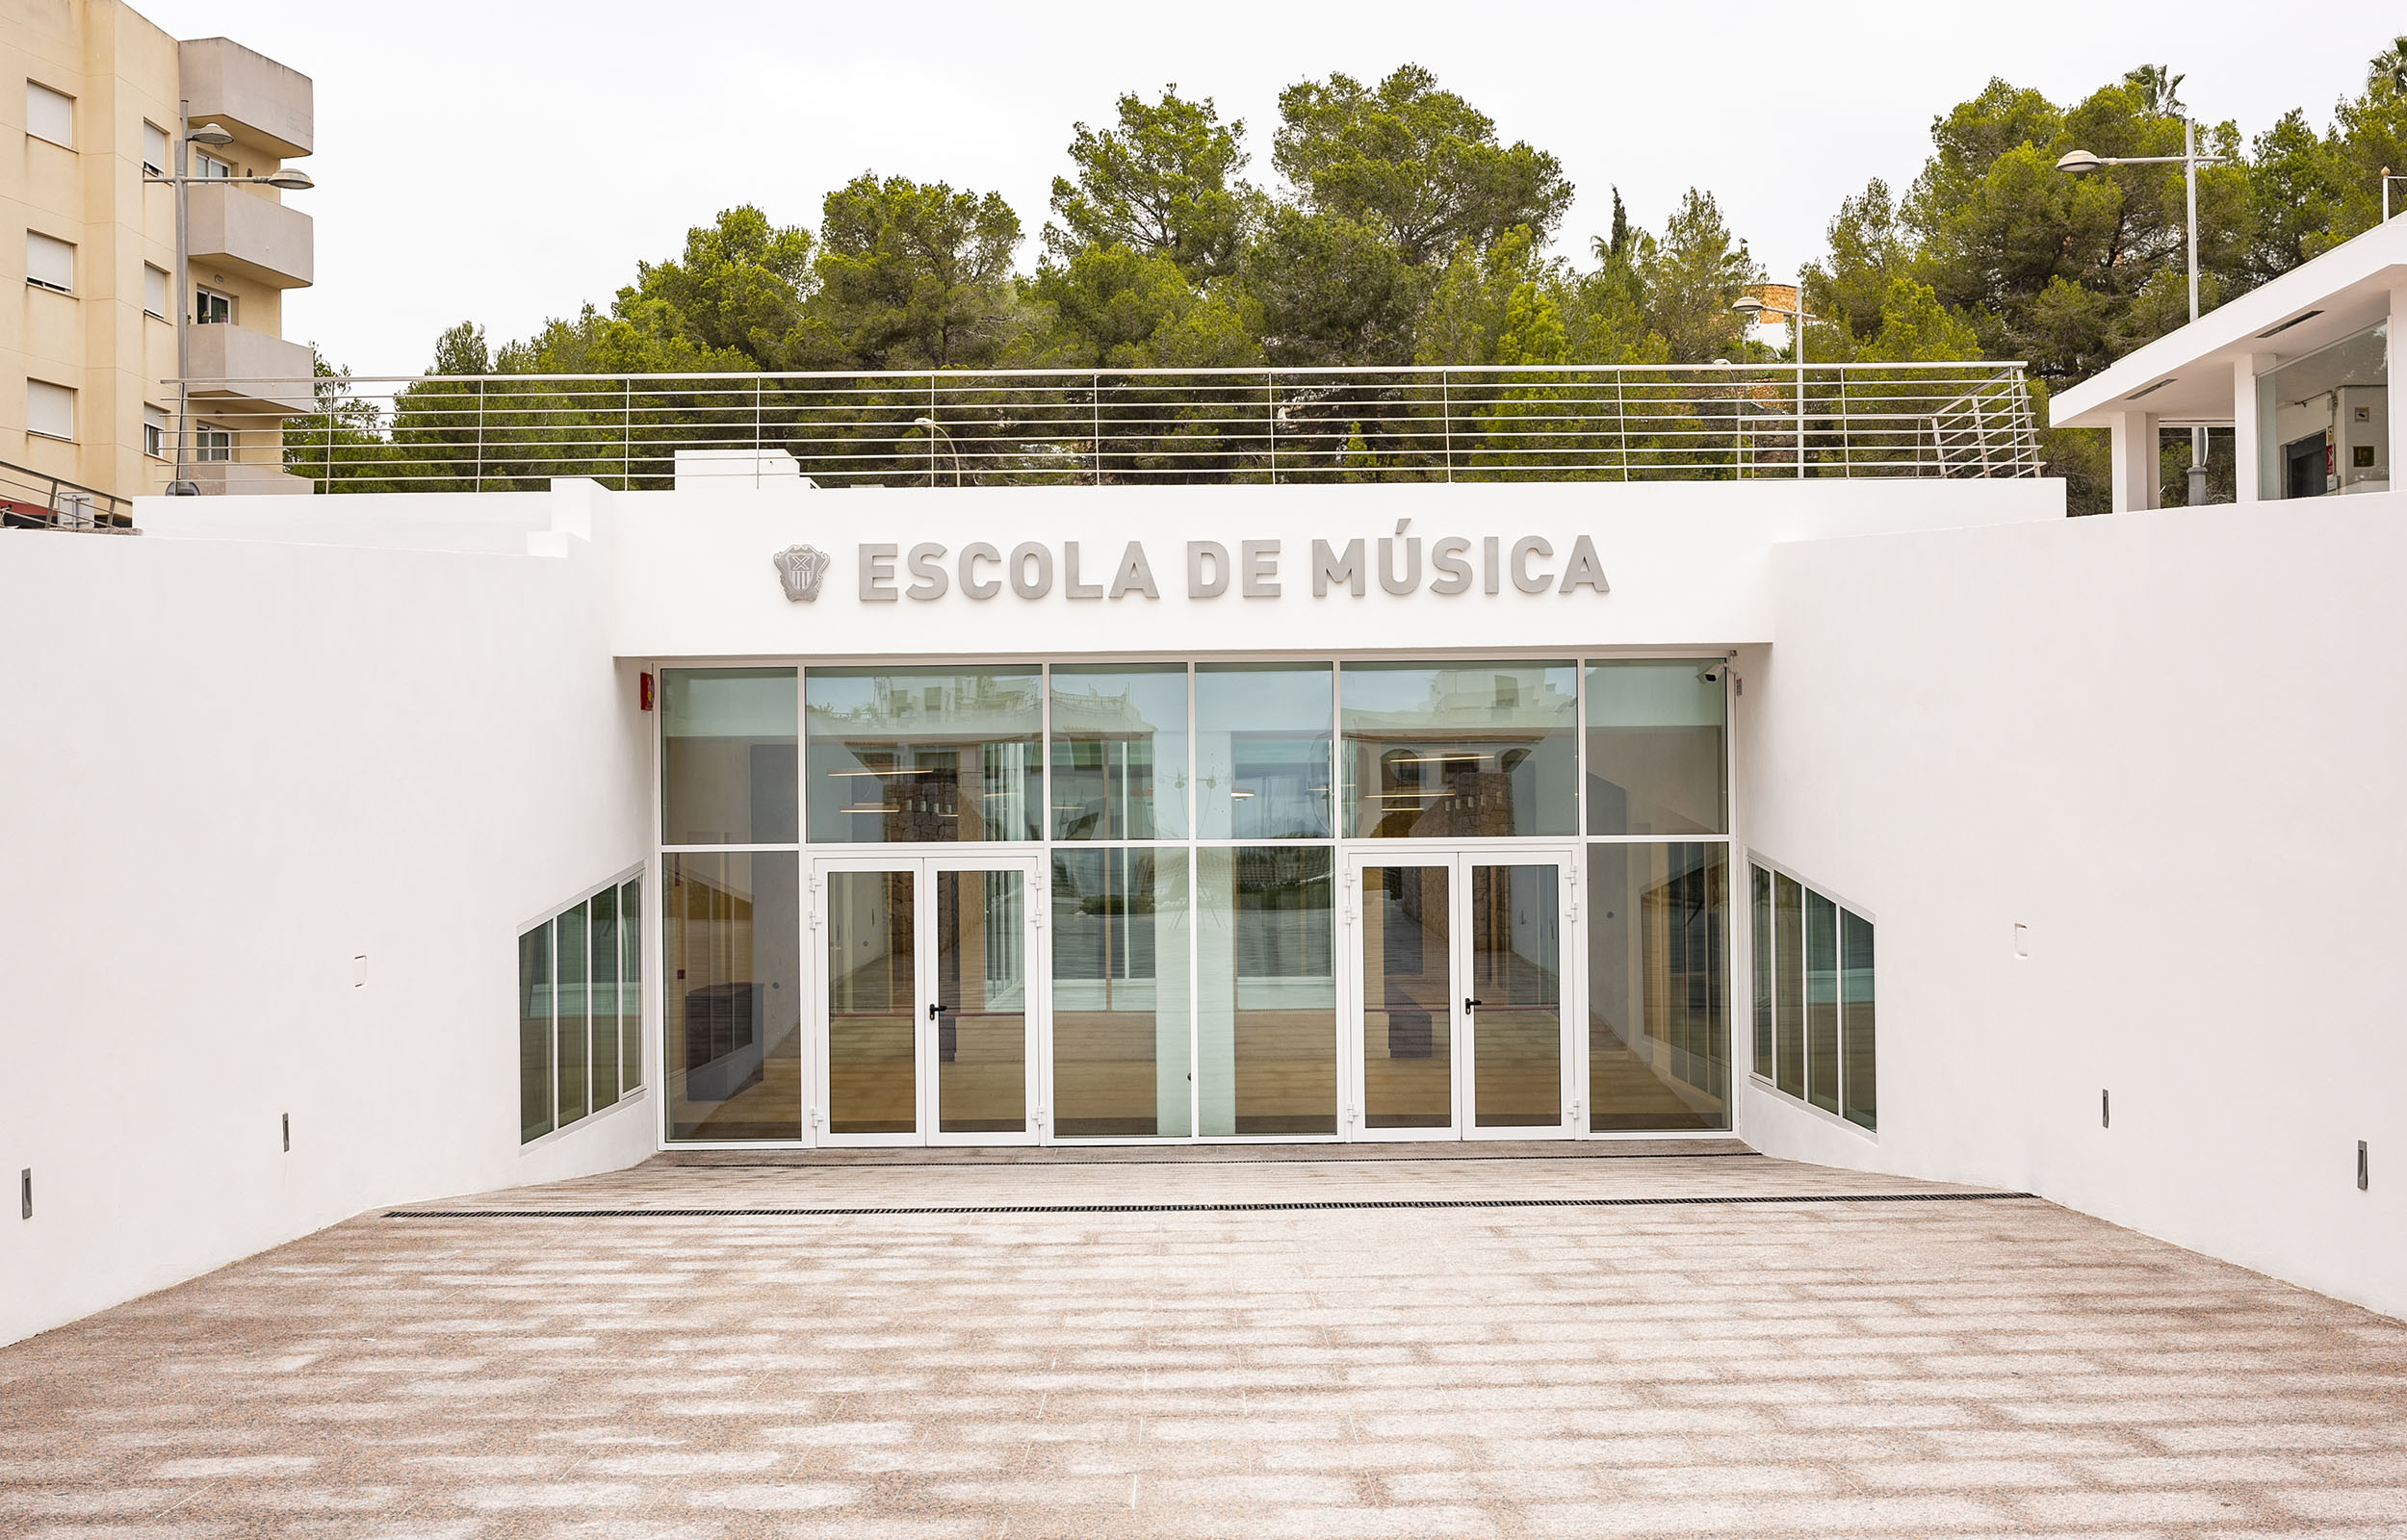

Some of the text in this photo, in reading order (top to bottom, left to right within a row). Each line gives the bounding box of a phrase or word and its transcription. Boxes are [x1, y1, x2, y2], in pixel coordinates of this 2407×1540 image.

[859, 518, 1610, 603] ESCOLA DE MÚSICA
